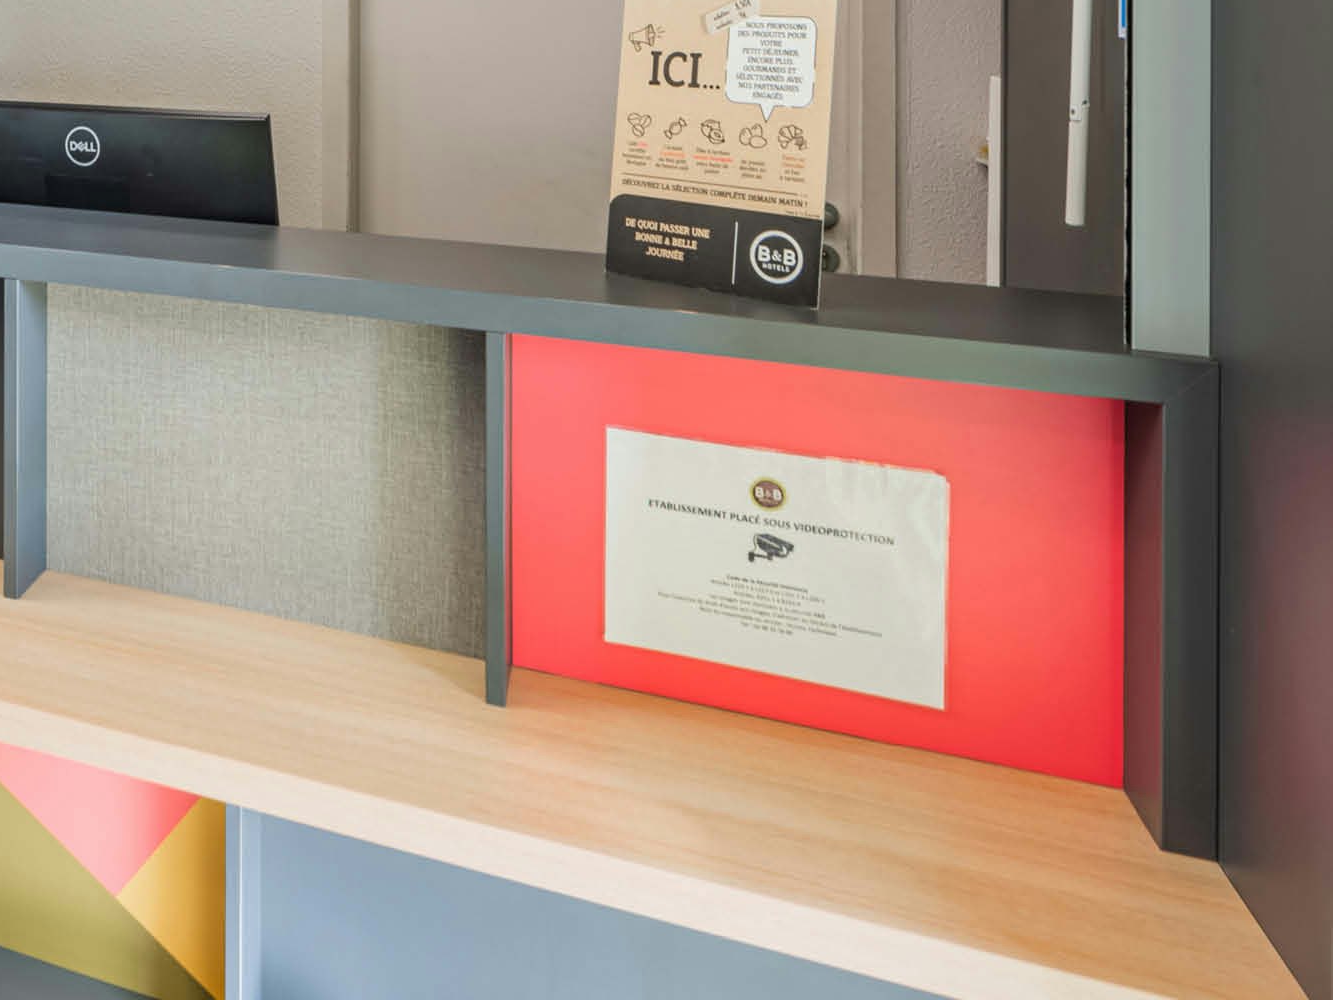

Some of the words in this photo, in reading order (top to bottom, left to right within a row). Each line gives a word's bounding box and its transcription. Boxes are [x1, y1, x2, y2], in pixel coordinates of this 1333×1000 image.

[747, 56, 774, 64] ENCORE
[648, 51, 720, 90] ICI...
[69, 140, 96, 153] DELL
[622, 178, 659, 189] DÉCOUVREZ
[672, 183, 708, 195] SÉLECTION
[710, 190, 746, 200] COMPLÈTE
[748, 194, 777, 203] DEMAIN
[779, 198, 803, 207] MATIN
[625, 217, 636, 227] DE
[638, 220, 658, 231] QUOI
[659, 221, 690, 236] PASSER
[692, 227, 711, 239] UNE
[635, 232, 663, 245] BONNE
[672, 238, 698, 250] BELLE
[645, 246, 685, 262] JOURNÉE
[757, 245, 796, 267] B&B
[761, 262, 790, 273] HOTELS
[754, 486, 783, 501] B&B
[648, 498, 727, 520] ETABLISSEMENT
[729, 511, 761, 525] PLACÉ
[763, 517, 791, 530] SOUS
[793, 522, 895, 546] VIDEOPROTECTION
